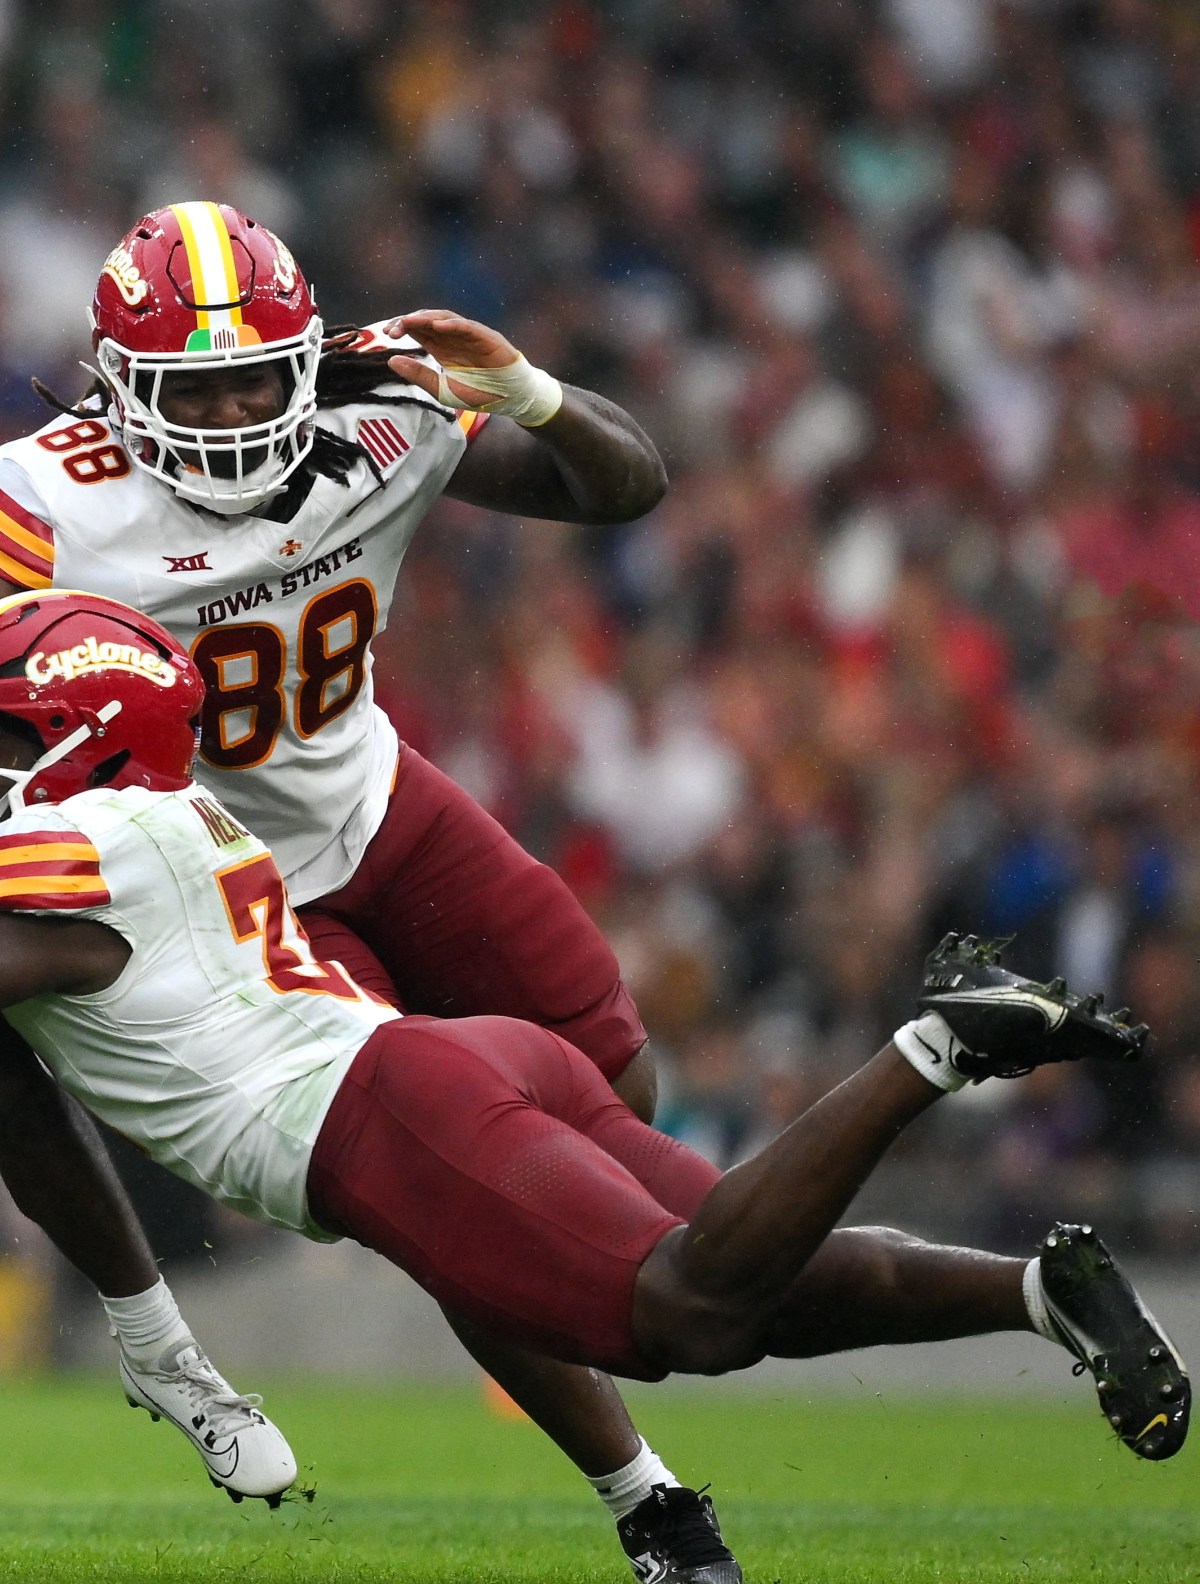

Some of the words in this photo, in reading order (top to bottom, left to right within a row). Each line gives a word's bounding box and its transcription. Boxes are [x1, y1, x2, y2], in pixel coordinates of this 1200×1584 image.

[36, 420, 131, 485] 88
[162, 551, 213, 573] XII
[197, 583, 273, 626] IOWA
[280, 537, 363, 598] STATE
[25, 636, 178, 688] Cyclones
[189, 577, 379, 770] 88
